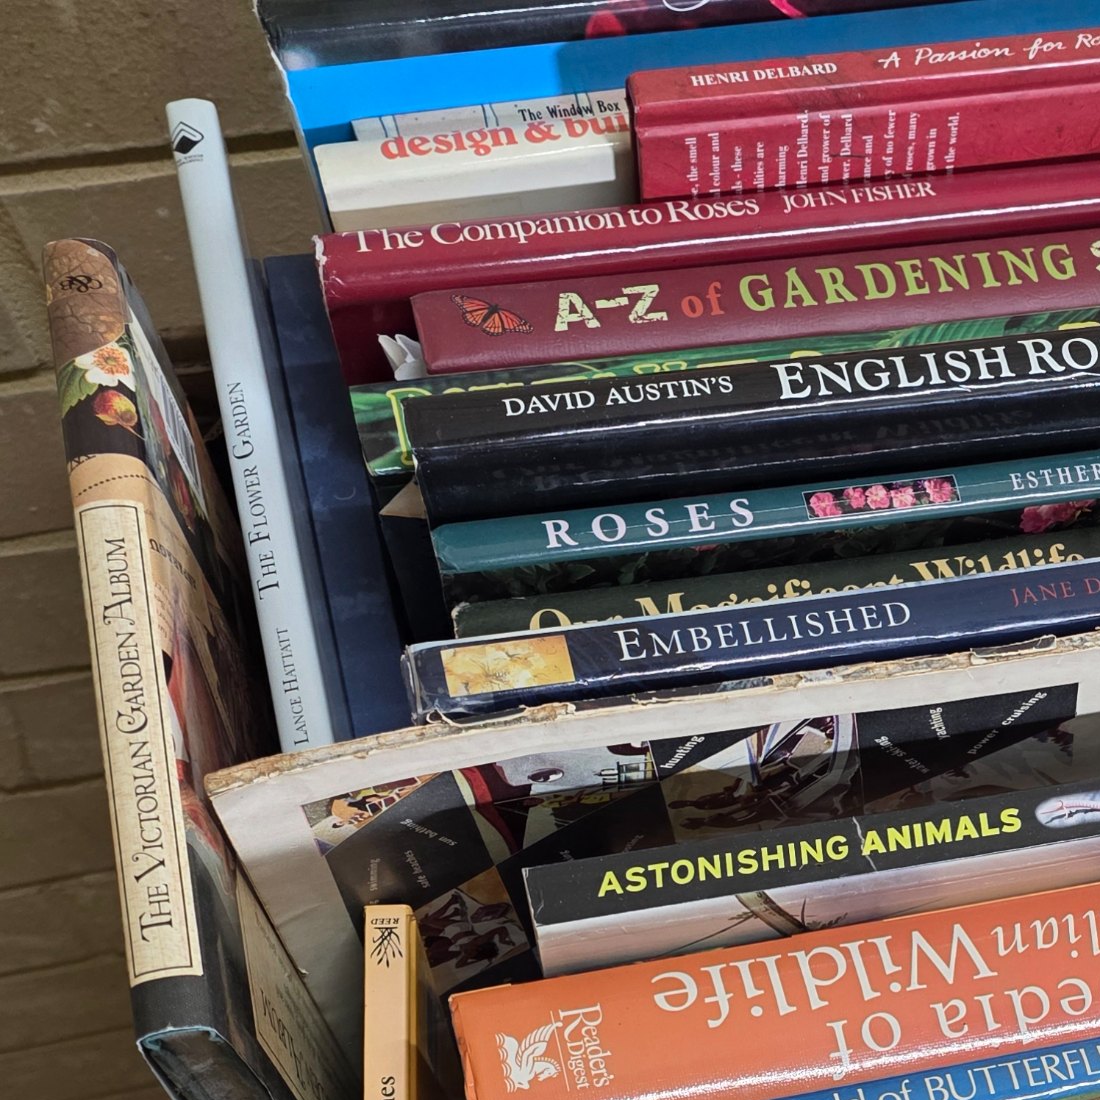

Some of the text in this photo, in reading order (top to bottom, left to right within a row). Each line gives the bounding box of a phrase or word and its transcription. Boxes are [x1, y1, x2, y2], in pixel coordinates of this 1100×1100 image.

[690, 62, 838, 87] HENRI DELBARD
[877, 51, 901, 69] A
[914, 42, 1015, 66] Passion
[1023, 37, 1067, 60] for
[518, 100, 620, 121] The Window Box
[840, 114, 852, 156] Delbard
[908, 112, 920, 140] many
[380, 121, 561, 160] design &
[685, 137, 698, 164] smell
[707, 132, 721, 187] colour and
[819, 113, 833, 164] grower of
[356, 182, 937, 253] The Companion to Roses JOHN FISHER
[554, 283, 668, 332] A-Z
[681, 280, 726, 318] of
[738, 243, 1077, 312] GARDENING
[502, 391, 597, 418] DAVID
[605, 376, 735, 405] AUSTIN'S
[770, 345, 1016, 400] ENGLISH
[226, 381, 280, 600] THE FLOWER GARDEN
[542, 499, 754, 548] ROSES
[613, 602, 911, 662] EMBELLISHED
[1010, 582, 1076, 608] JANE
[276, 627, 310, 746] LANCE HATTATT
[1001, 691, 1048, 726] cruising
[103, 537, 174, 943] THE VICTORIAN GARDEN ALBUM
[660, 736, 705, 768] hunting
[598, 835, 849, 898] ASTONISHING
[861, 808, 1023, 856] ANIMALS
[370, 917, 400, 926] REED
[652, 923, 998, 1030] Wildlife
[560, 1003, 613, 1087] Reader's
[566, 1040, 591, 1090] Digest
[824, 1012, 903, 1081] of
